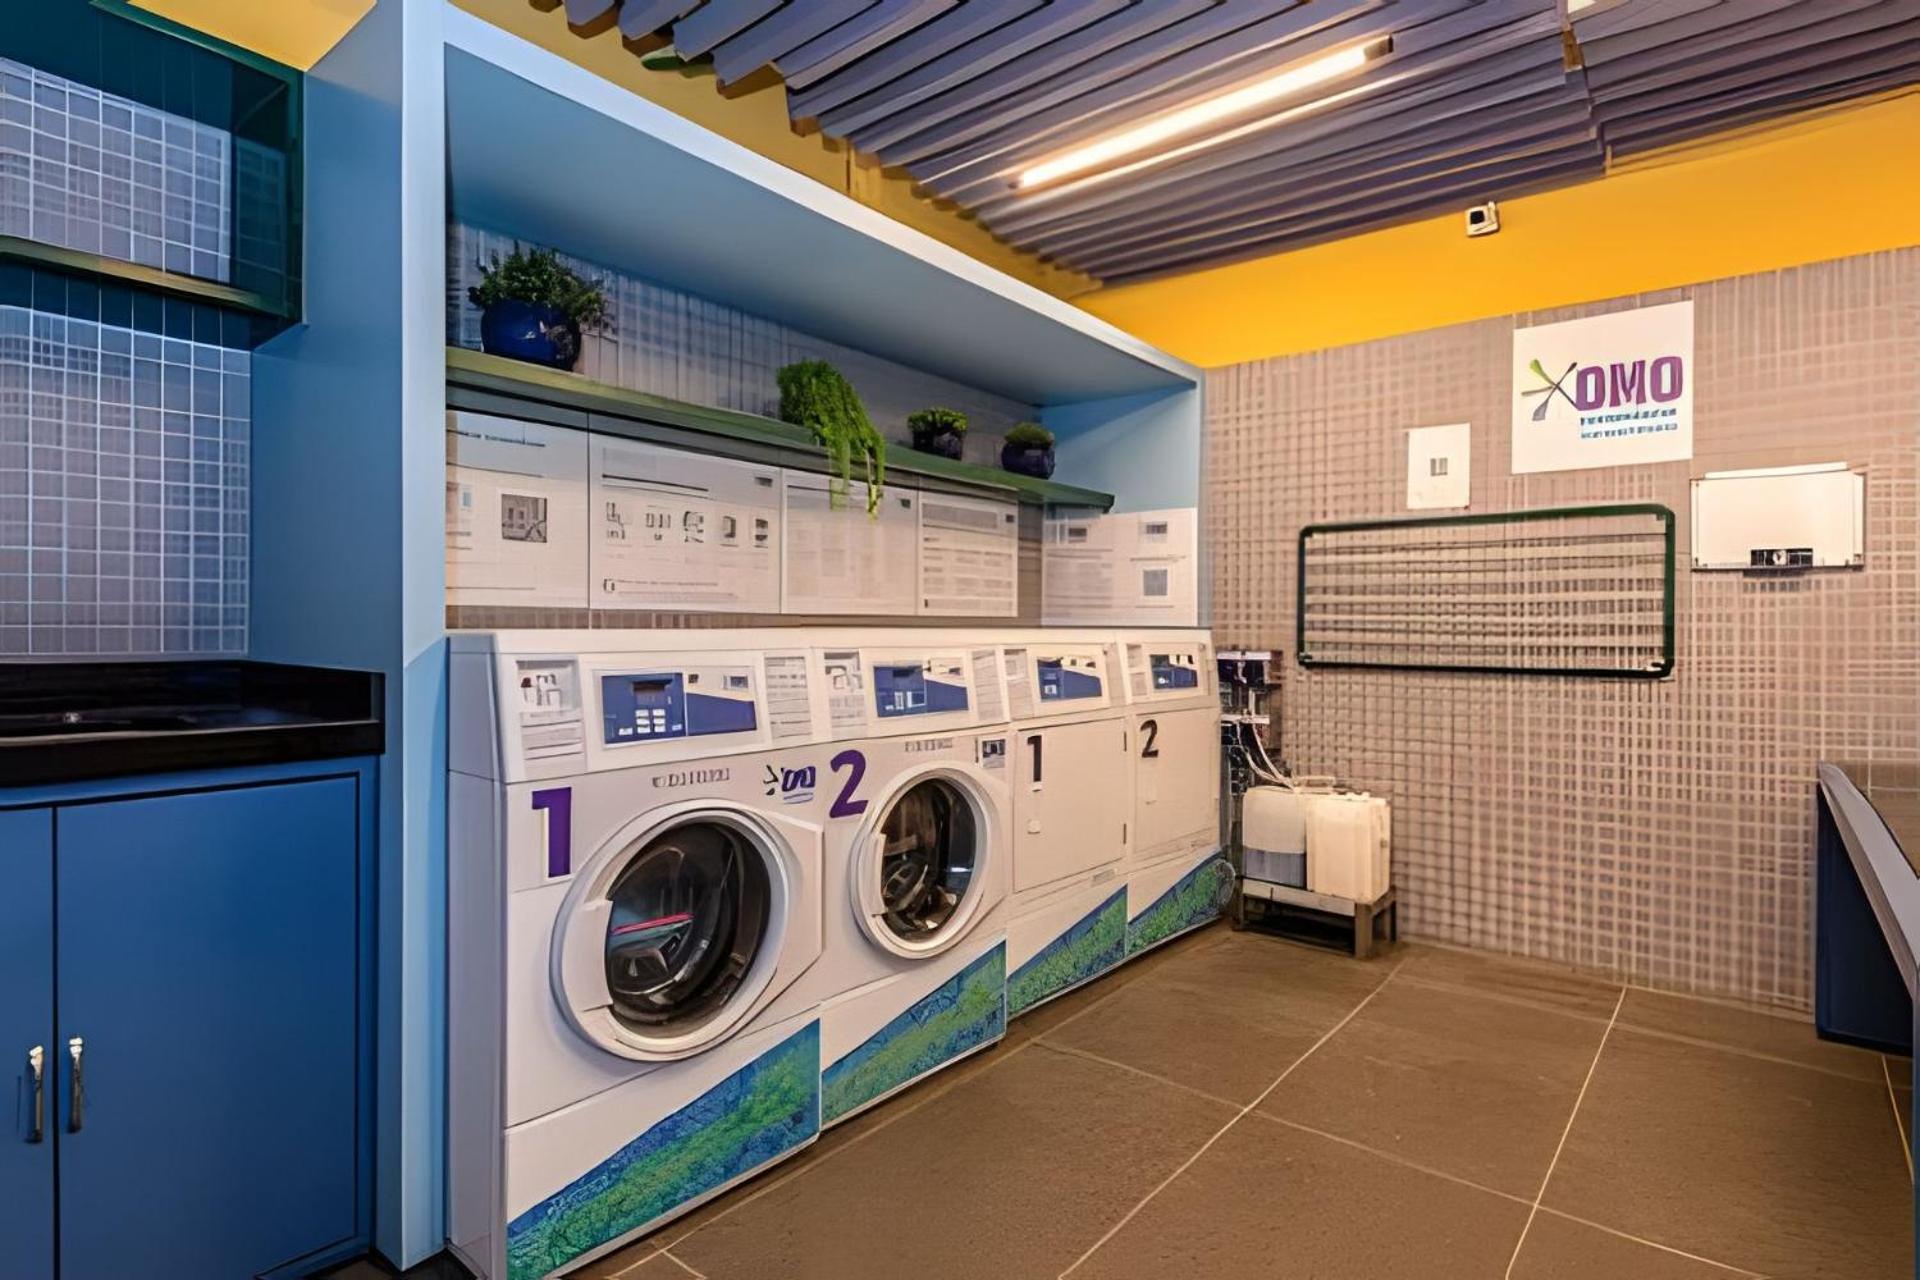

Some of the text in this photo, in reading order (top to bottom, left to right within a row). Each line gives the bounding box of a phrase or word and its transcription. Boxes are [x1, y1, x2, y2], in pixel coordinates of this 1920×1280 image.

[1576, 356, 1683, 411] OMO
[1027, 735, 1042, 782] 1
[1140, 719, 1159, 758] 2
[829, 750, 869, 818] 2
[532, 787, 572, 878] 1
